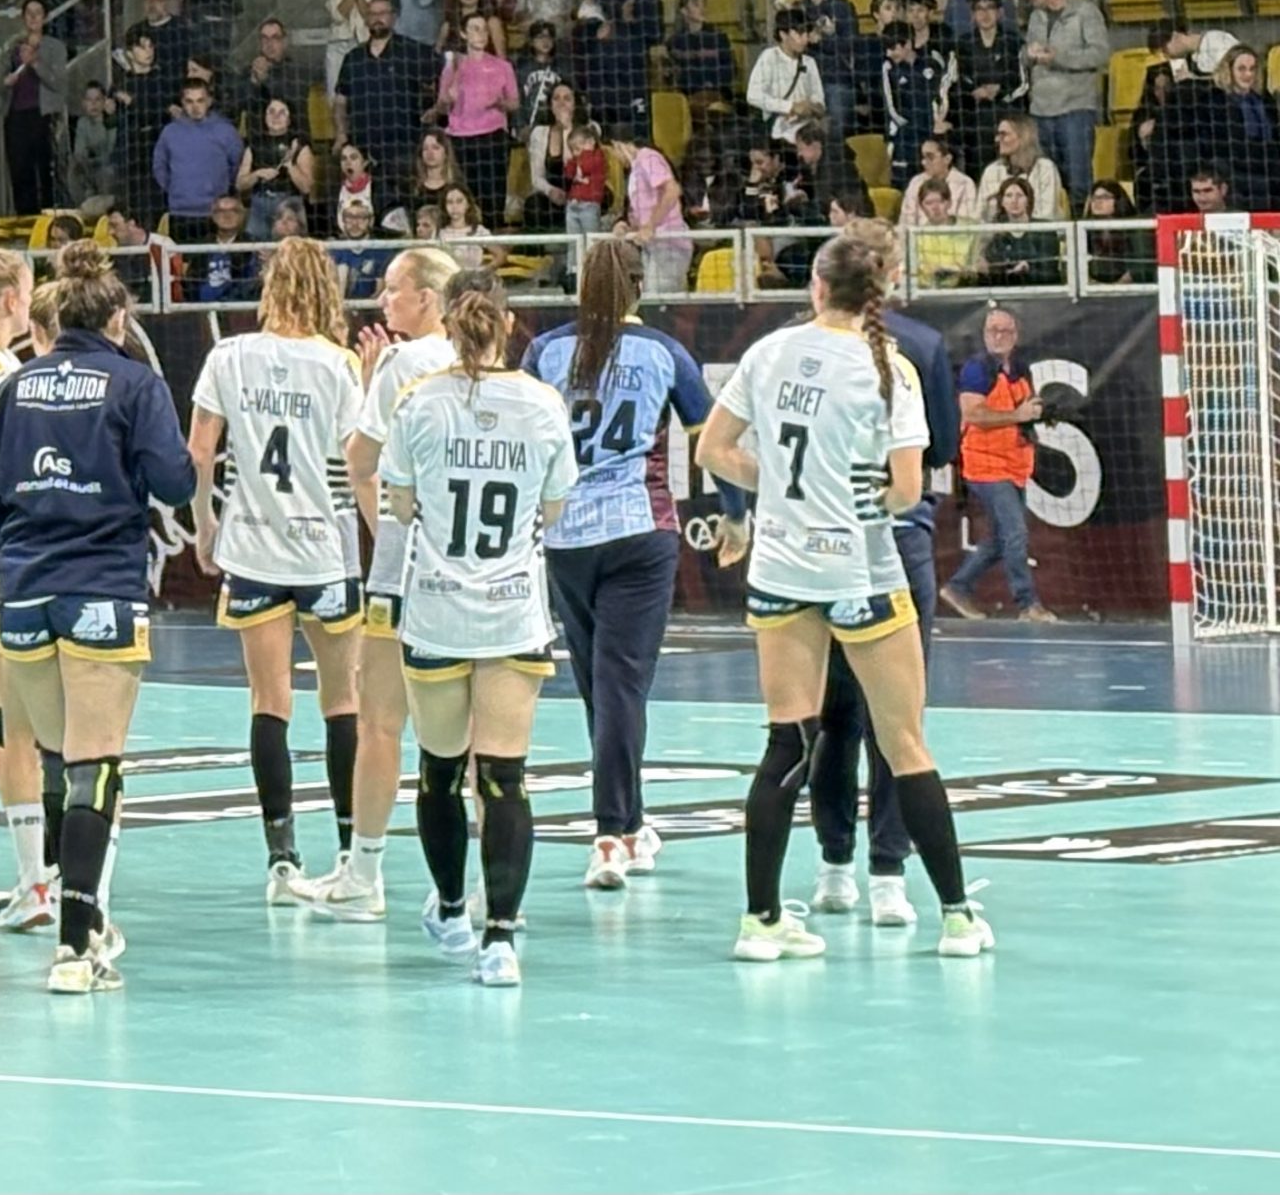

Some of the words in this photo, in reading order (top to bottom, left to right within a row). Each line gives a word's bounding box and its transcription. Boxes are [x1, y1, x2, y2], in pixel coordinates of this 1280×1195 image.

[571, 399, 637, 467] 24
[775, 381, 827, 417] GAYET
[260, 425, 295, 495] 4
[445, 435, 528, 473] HOLEJOVA
[777, 422, 810, 501] 7
[446, 477, 519, 559] 19
